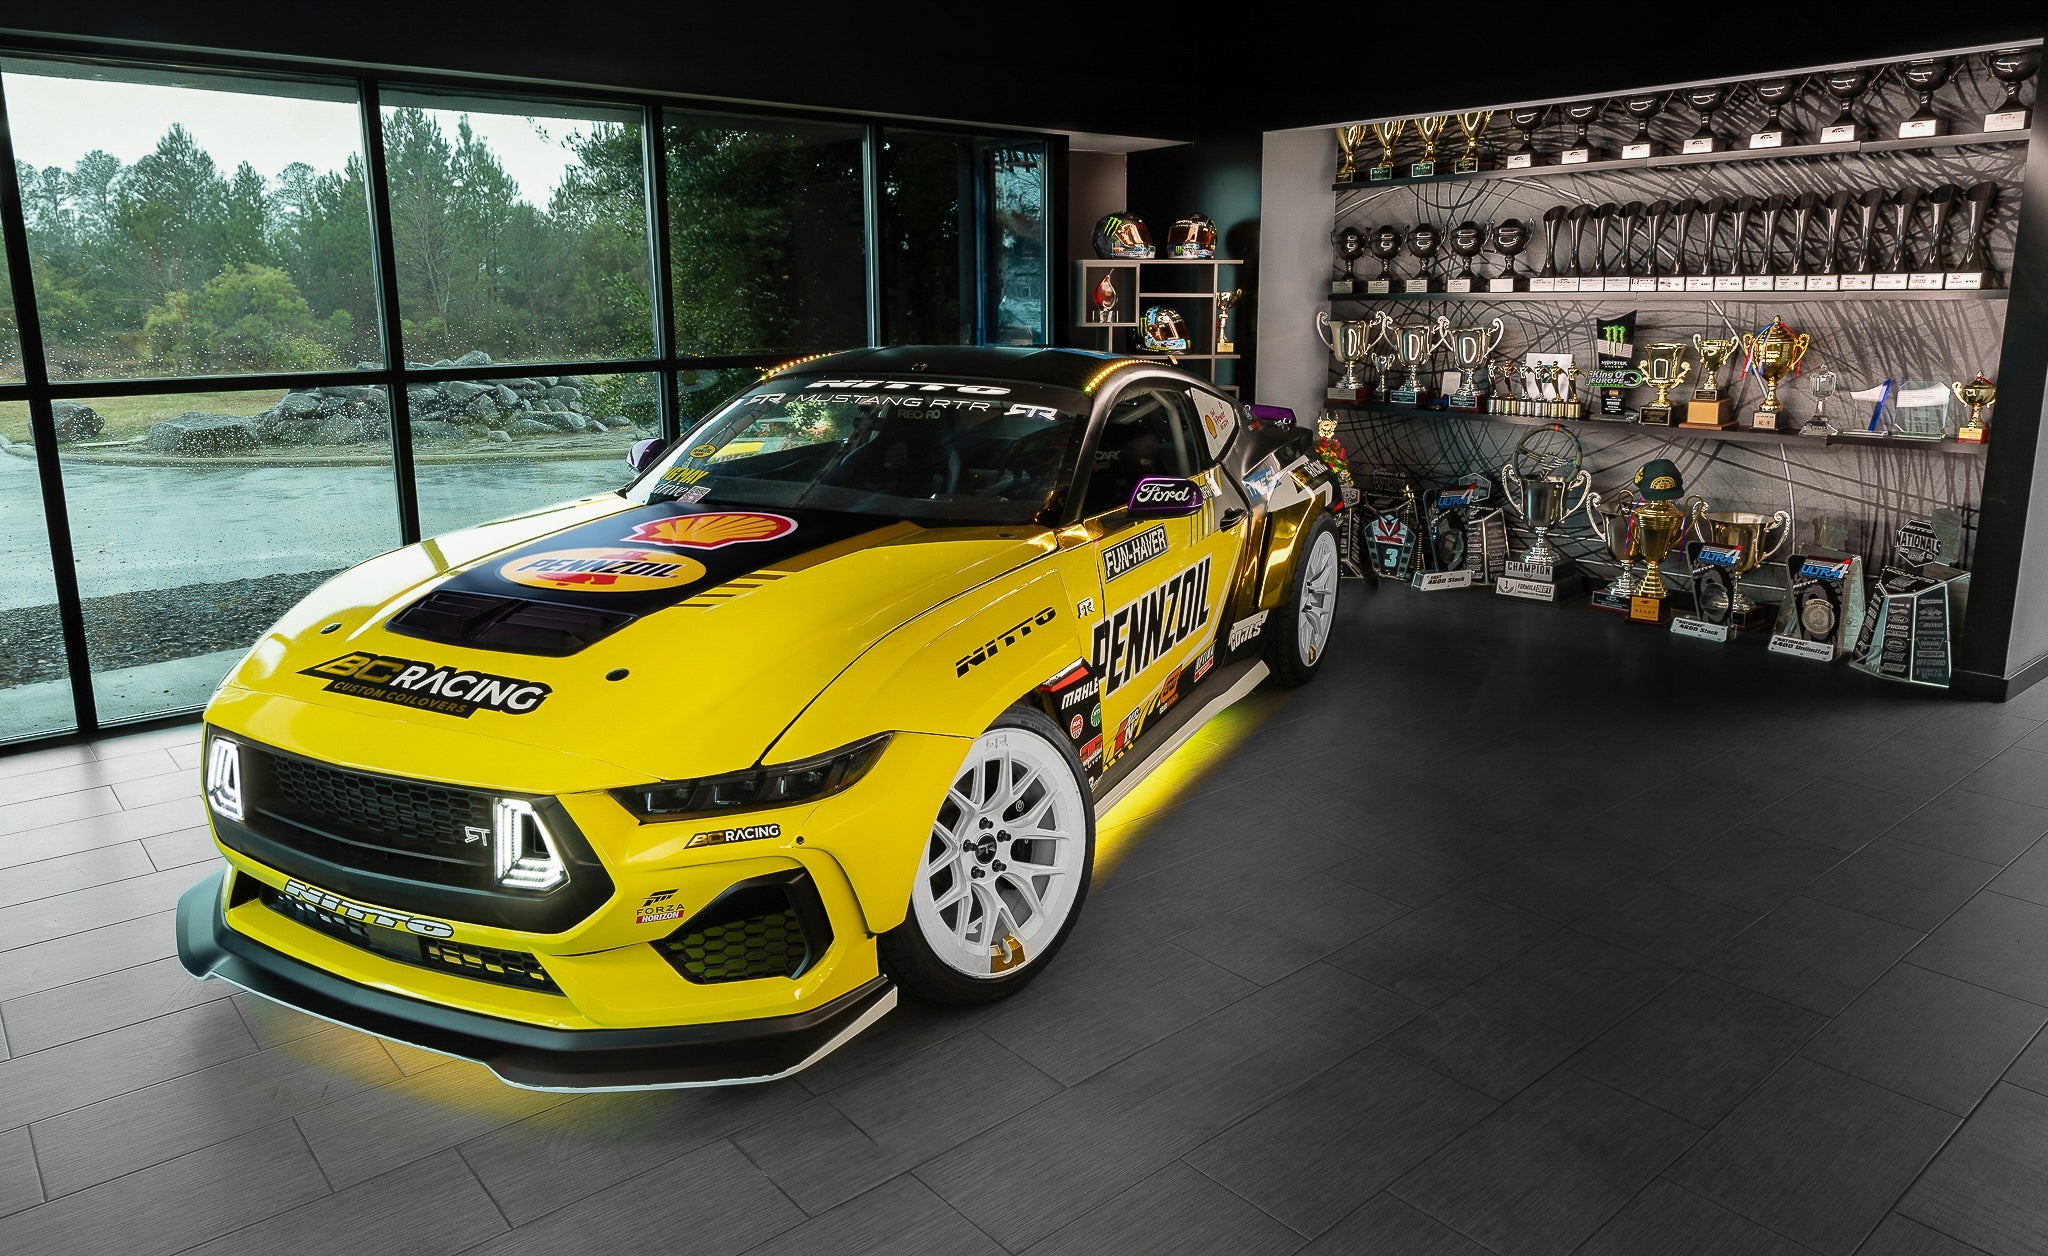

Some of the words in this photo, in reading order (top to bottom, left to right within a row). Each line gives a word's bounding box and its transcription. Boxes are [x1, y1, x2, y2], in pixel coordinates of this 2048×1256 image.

[805, 379, 1011, 396] NITTO
[795, 394, 924, 407] MUSTANG
[930, 399, 991, 412] RTR
[898, 409, 941, 420] RECRO
[1136, 483, 1190, 502] Ford
[1105, 528, 1168, 577] FUN-HAVER
[1895, 531, 1942, 556] NATIONALS
[517, 557, 686, 578] PENNZOIL
[1384, 548, 1398, 567] 3
[1507, 562, 1551, 575] CHAMPION
[1091, 553, 1212, 700] PENNZOIL
[955, 606, 1057, 678] NITTO
[1794, 644, 1830, 656] Unlimited
[315, 654, 404, 684] BC
[390, 665, 545, 711] RACING
[1061, 676, 1100, 710] MAHLE
[334, 681, 387, 698] CUSTOM
[386, 691, 468, 714] COILOVERS
[689, 832, 726, 848] BC
[725, 825, 780, 842] RACING
[284, 879, 455, 939] NITTO
[636, 904, 685, 916] FORZA
[641, 911, 679, 923] HORIZON
